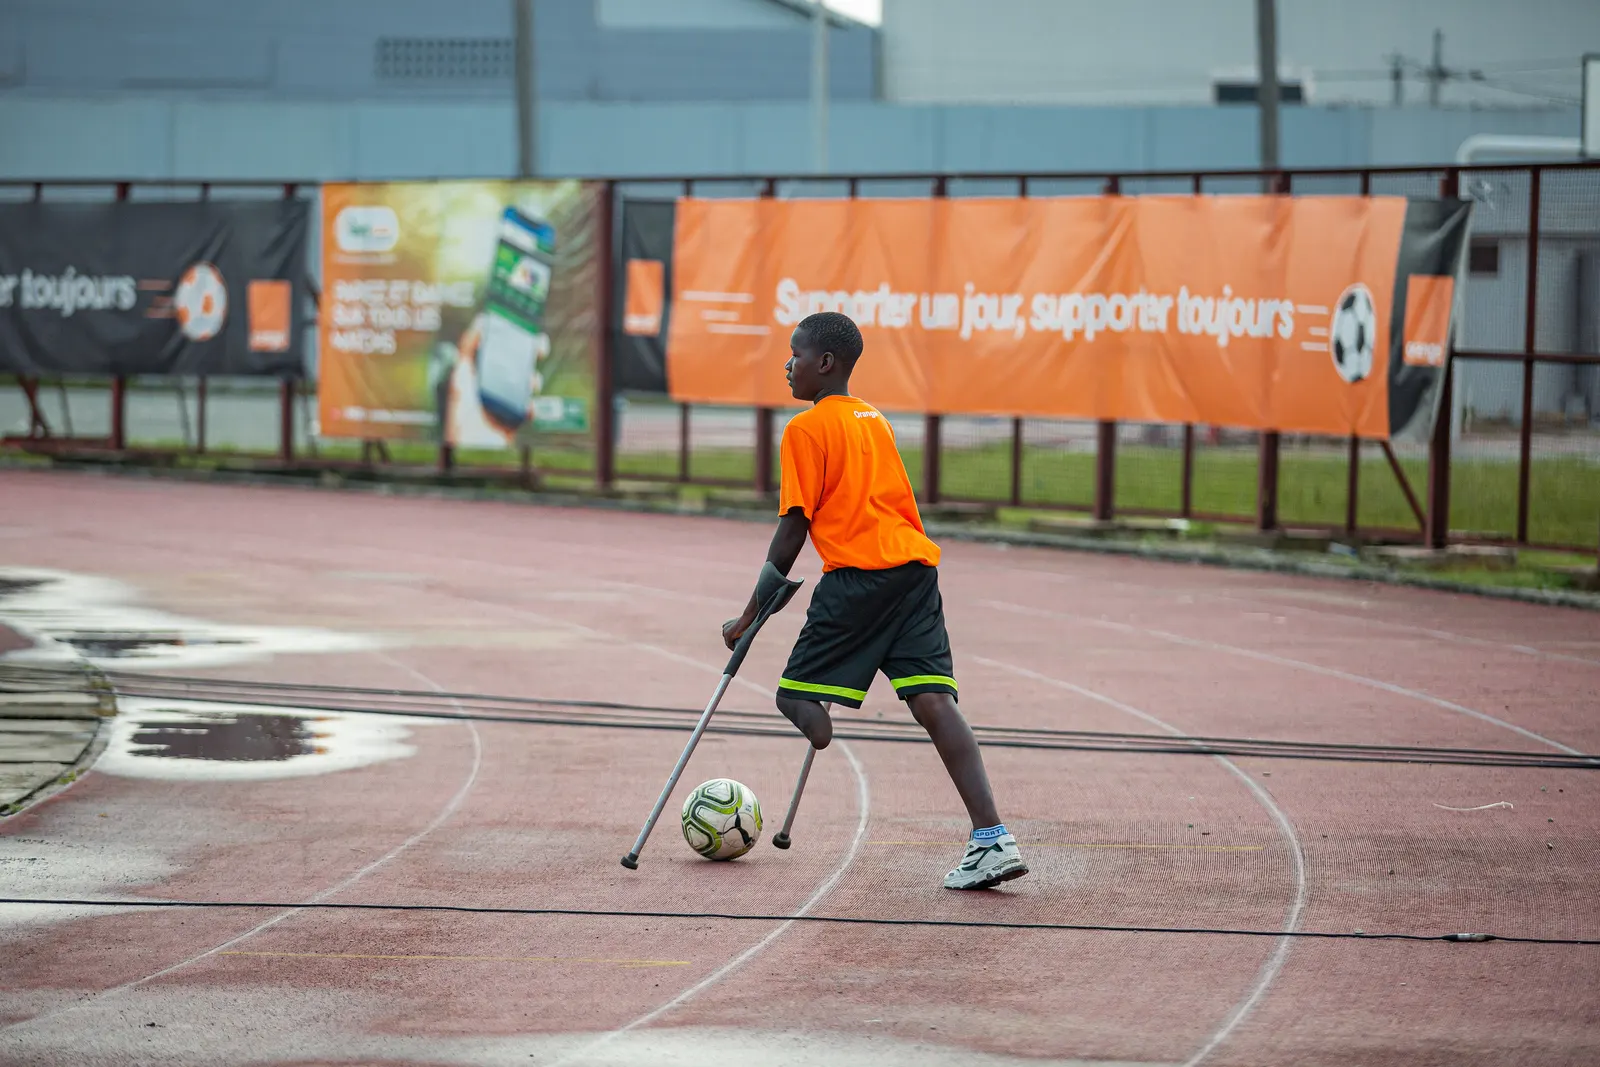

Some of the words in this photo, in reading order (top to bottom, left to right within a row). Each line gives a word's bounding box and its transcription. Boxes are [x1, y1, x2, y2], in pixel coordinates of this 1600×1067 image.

[21, 265, 137, 317] toujours
[960, 281, 1026, 341] jour,
[1030, 286, 1174, 342] supporter
[1177, 284, 1294, 348] toujours
